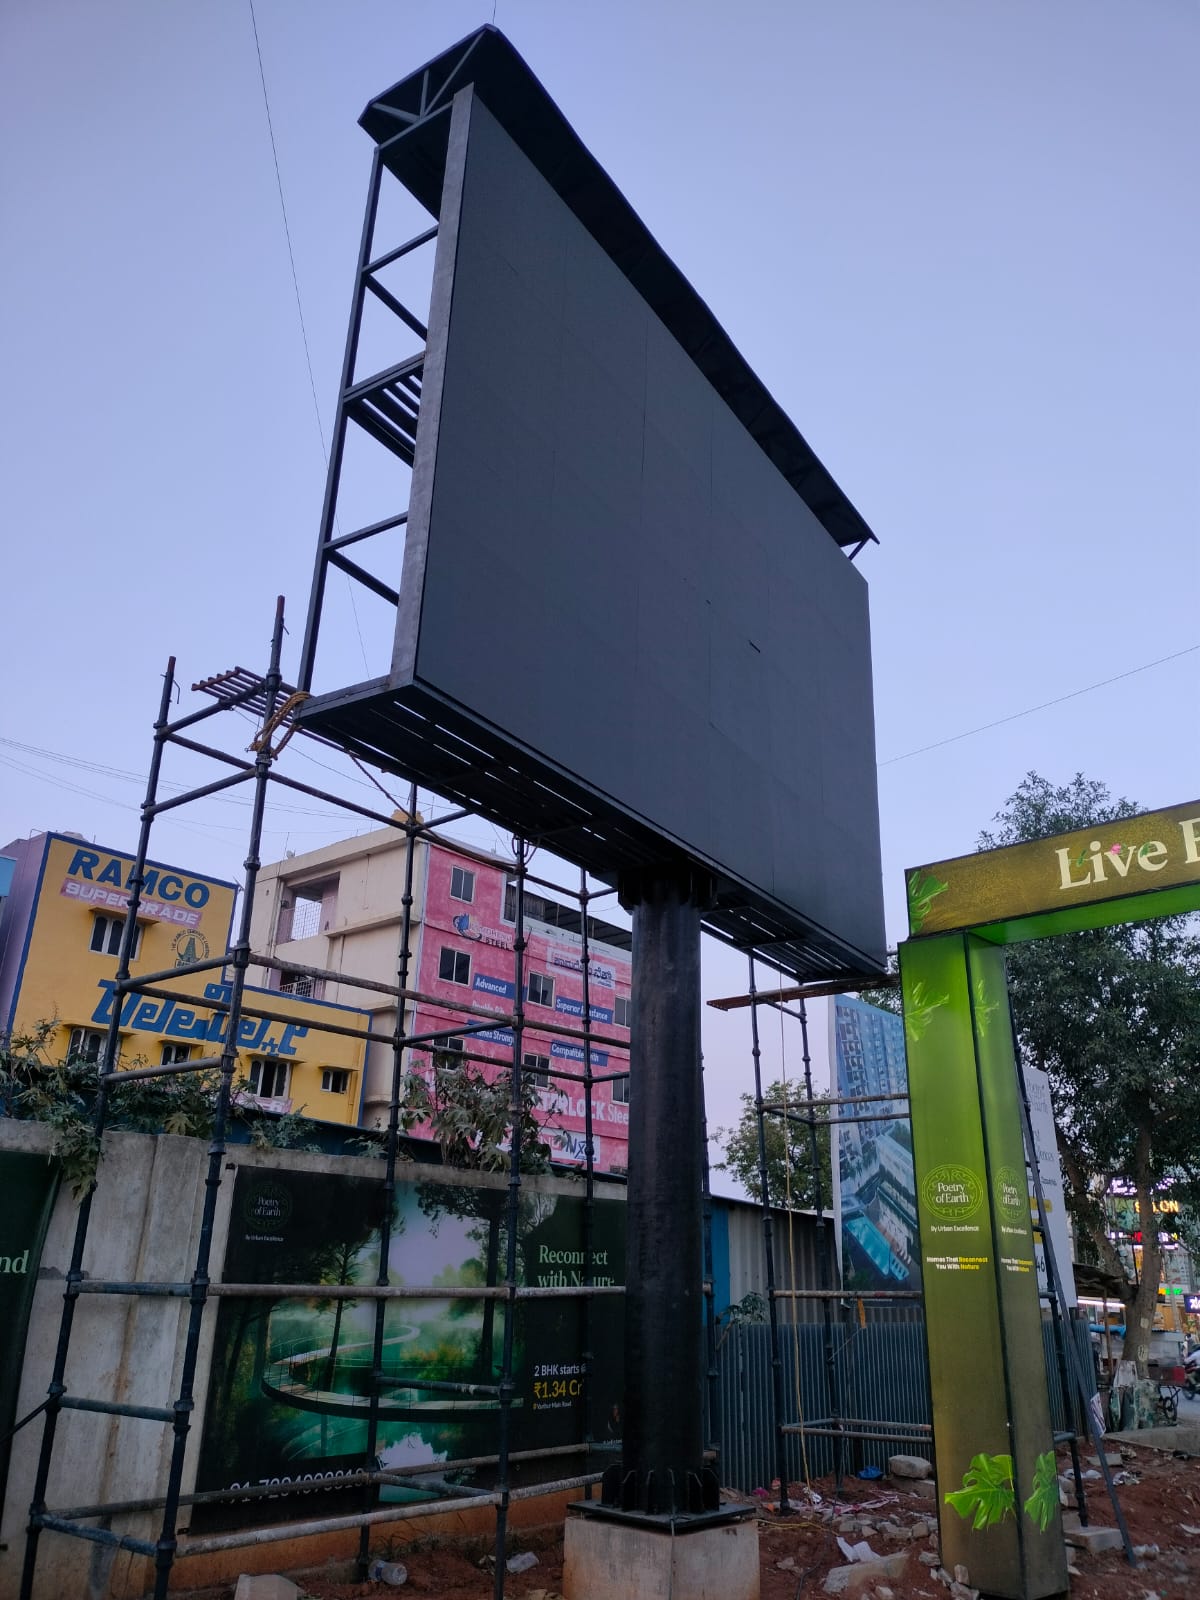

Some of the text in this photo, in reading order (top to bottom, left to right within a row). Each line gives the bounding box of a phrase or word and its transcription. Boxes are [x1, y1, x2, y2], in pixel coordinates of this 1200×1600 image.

[1055, 841, 1168, 889] Live
[67, 849, 210, 908] RAMCO
[475, 977, 507, 994] Advanced
[556, 998, 580, 1014] Superior
[937, 1182, 966, 1193] Poetry
[257, 1195, 280, 1206] Poetry
[935, 1193, 969, 1203] of Earth
[254, 1206, 281, 1217] of Earth
[930, 1225, 937, 1233] By
[537, 1270, 568, 1288] with
[534, 1365, 540, 1377] 2
[541, 1363, 559, 1376] BHK
[559, 1363, 581, 1375] starts
[533, 1378, 583, 1399] ₹1.34 Cr
